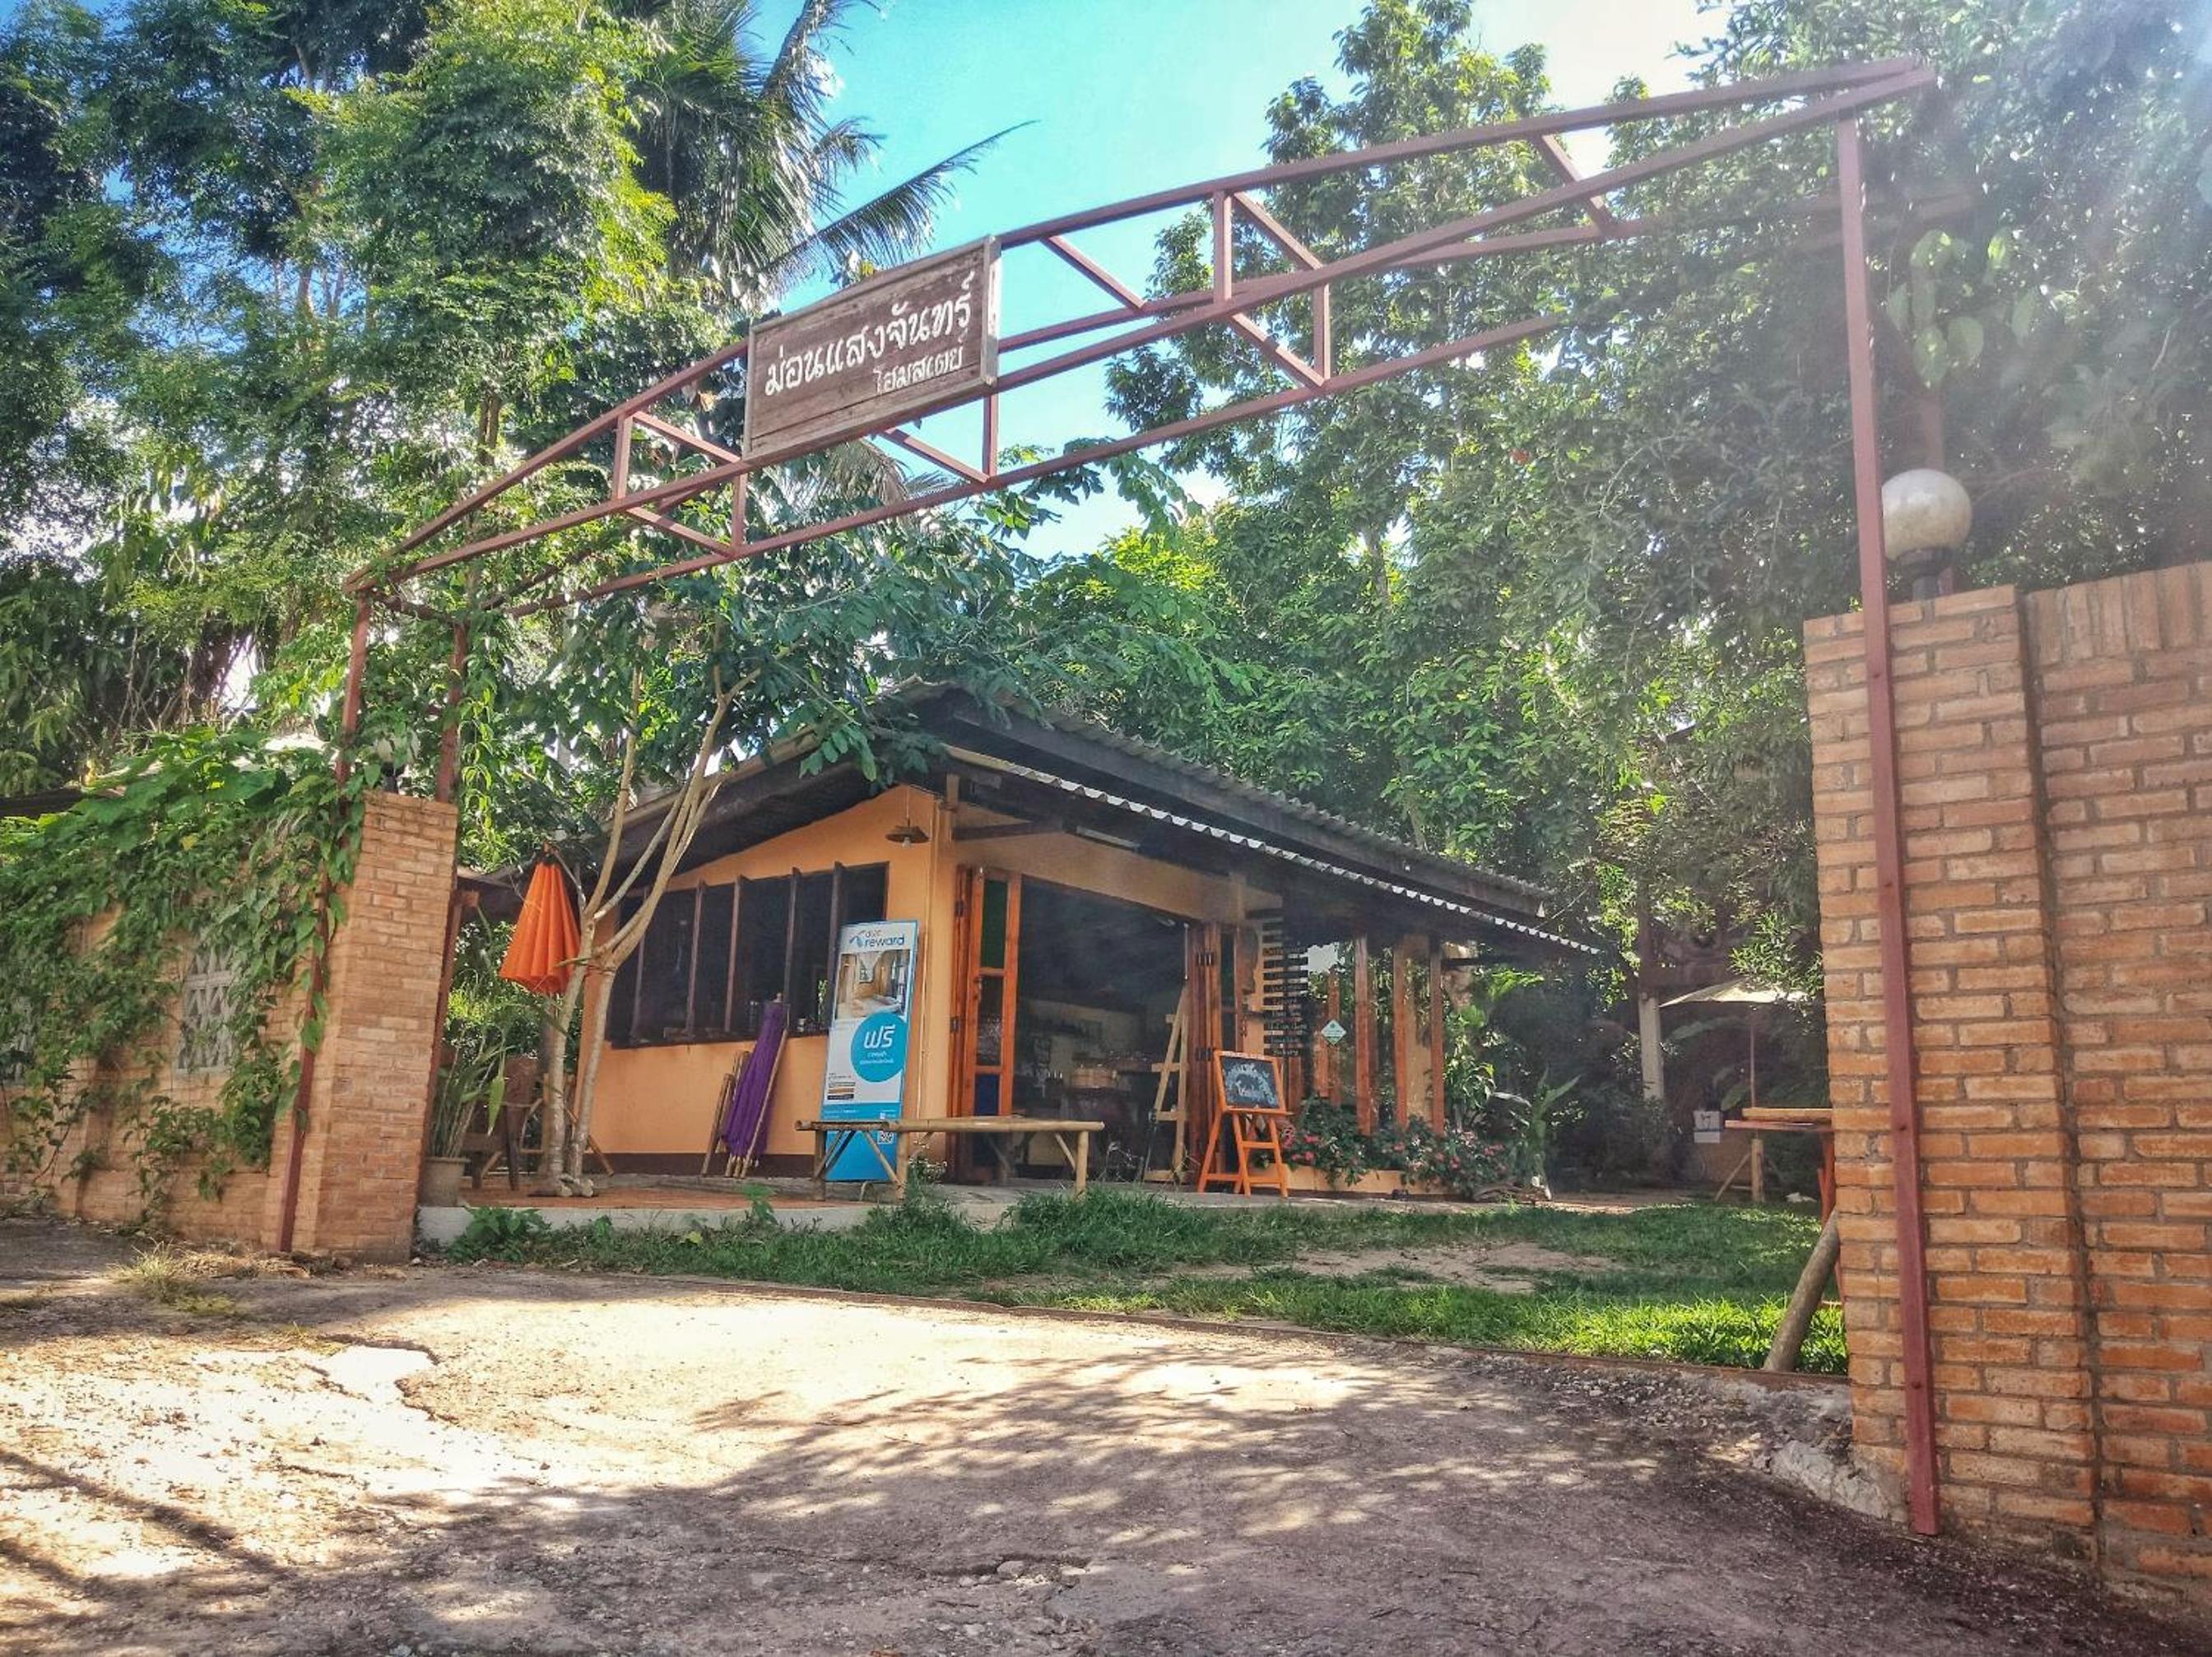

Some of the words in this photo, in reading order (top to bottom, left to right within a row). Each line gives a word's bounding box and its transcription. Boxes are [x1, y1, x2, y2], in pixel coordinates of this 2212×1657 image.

[764, 270, 975, 396] ม่อนแสงจันทร์
[864, 934, 905, 948] reward
[863, 1023, 896, 1049] ฟรี
